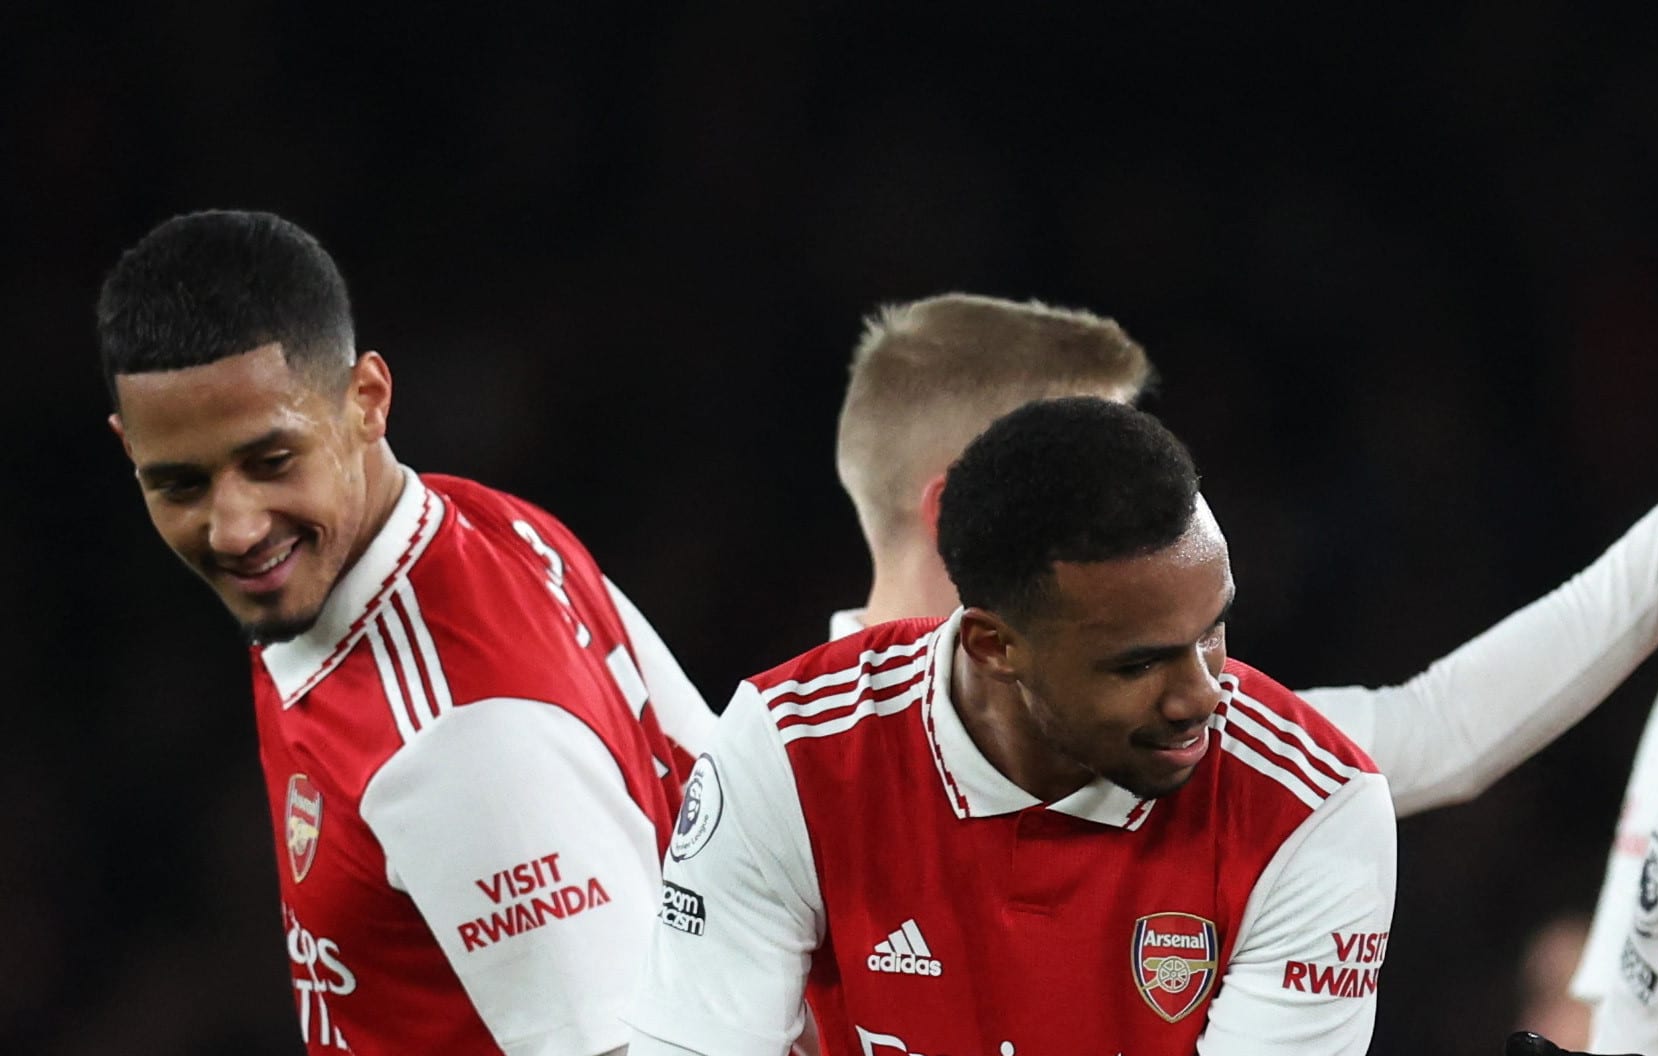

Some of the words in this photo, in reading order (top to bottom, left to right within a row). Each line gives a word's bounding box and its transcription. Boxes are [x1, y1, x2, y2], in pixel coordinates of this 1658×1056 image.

[474, 851, 562, 904] VISIT
[457, 876, 612, 953] RWANDA
[663, 885, 699, 915] oom
[1143, 929, 1205, 949] Arsenal
[867, 951, 943, 977] adidas
[1282, 960, 1379, 998] RWAN
